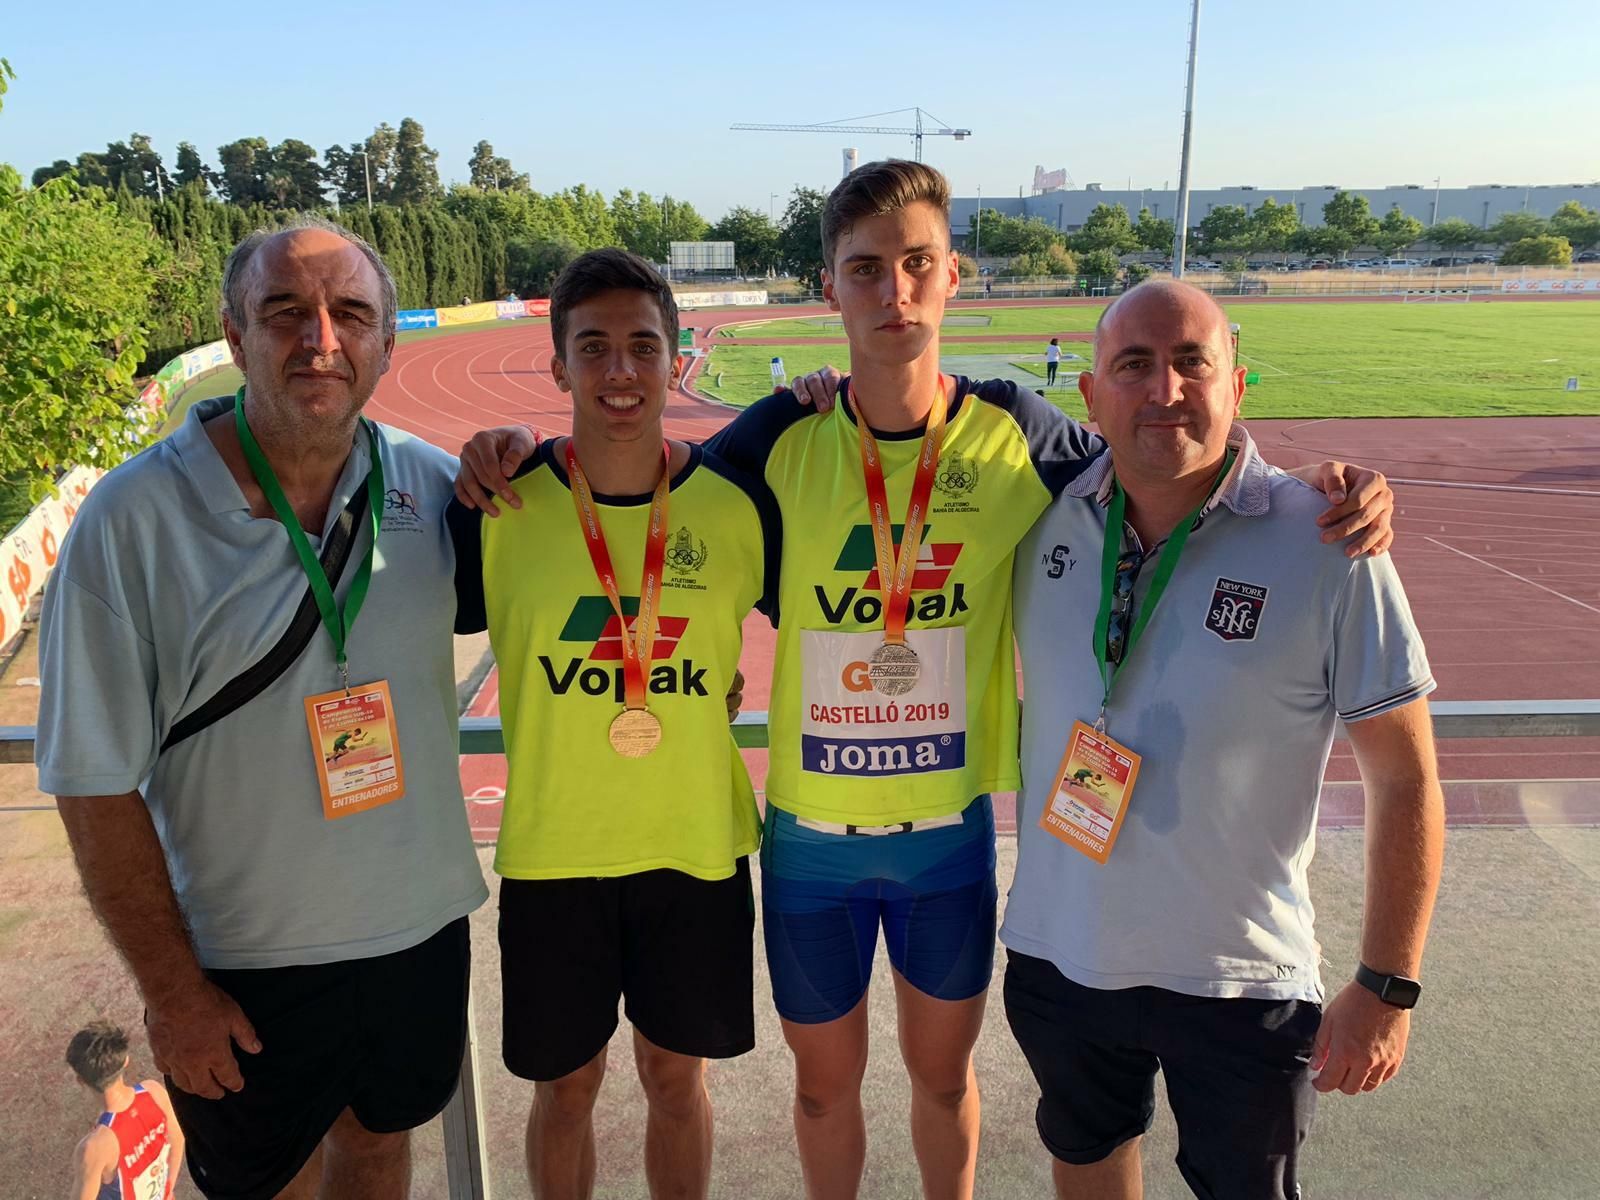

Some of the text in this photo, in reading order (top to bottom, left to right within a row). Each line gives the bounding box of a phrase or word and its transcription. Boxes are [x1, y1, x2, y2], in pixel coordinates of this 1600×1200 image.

[1220, 580, 1263, 597] NEW YORK
[810, 701, 950, 724] CASTELLÓ 2019
[331, 781, 399, 809] ENTRENADORES
[1046, 813, 1105, 854] ENTRENADORES
[1276, 964, 1297, 979] NY
